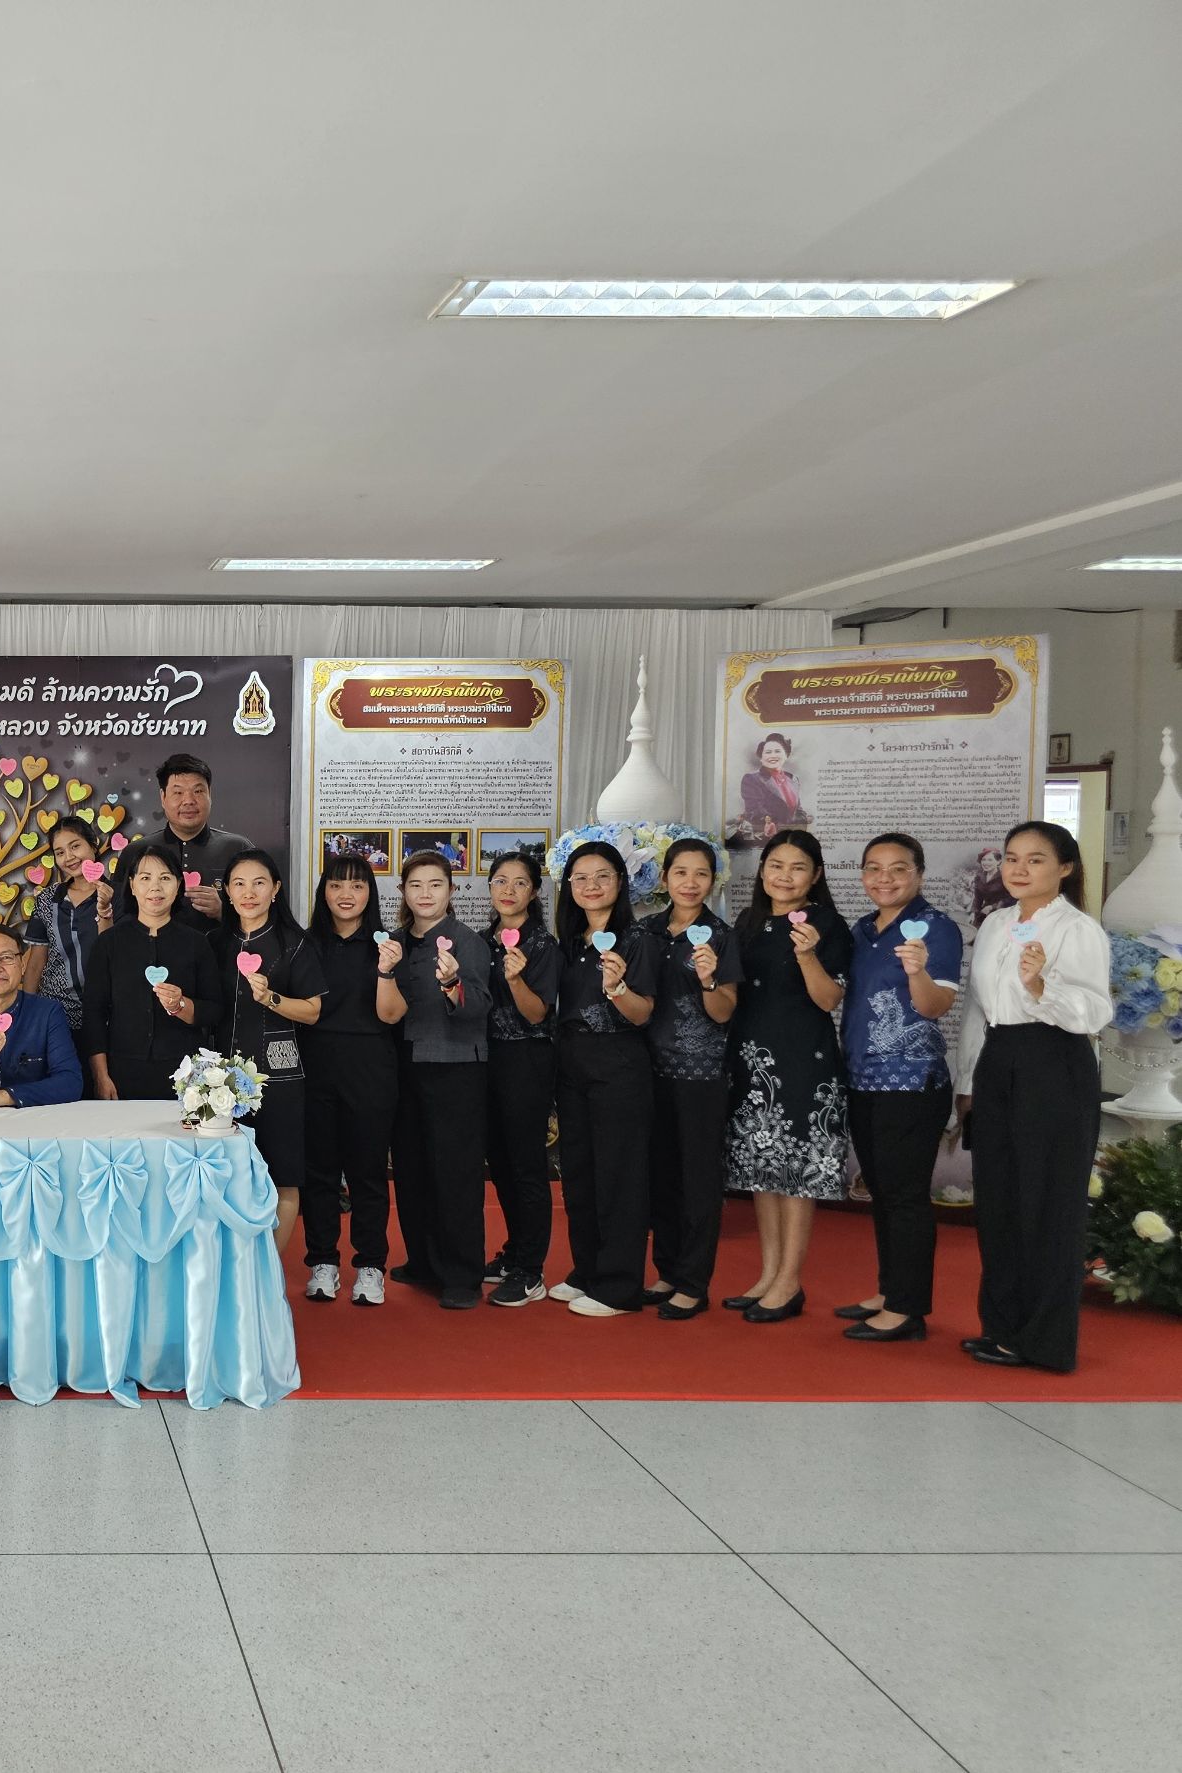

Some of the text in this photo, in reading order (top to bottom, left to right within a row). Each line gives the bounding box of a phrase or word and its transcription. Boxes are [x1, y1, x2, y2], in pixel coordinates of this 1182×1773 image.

[41, 676, 170, 703] ล้านความรัก
[57, 712, 207, 736] จังหวัดชัยนาท
